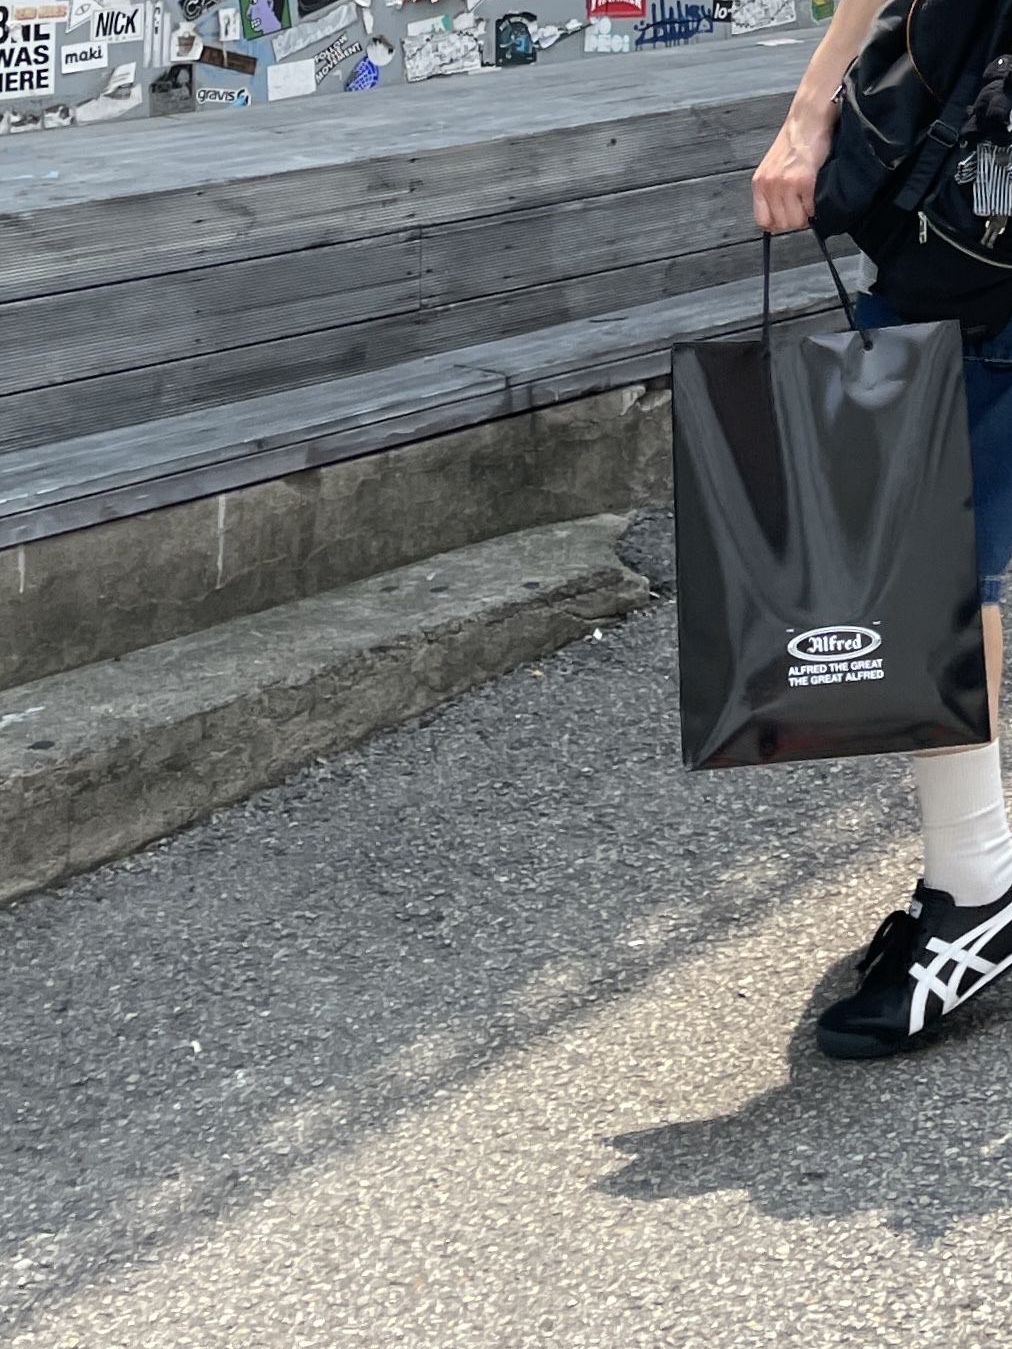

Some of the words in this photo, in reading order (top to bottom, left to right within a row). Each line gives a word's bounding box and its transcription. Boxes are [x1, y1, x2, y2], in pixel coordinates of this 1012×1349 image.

[95, 8, 139, 38] NICK
[64, 45, 104, 65] maki
[198, 88, 235, 103] gravis
[807, 633, 863, 653] Alfred
[788, 664, 828, 676] ALFRED
[828, 662, 849, 673] THE
[850, 658, 884, 671] GREAT
[788, 677, 809, 687] THE
[810, 673, 844, 686] GREAT
[845, 669, 885, 682] ALFRED
